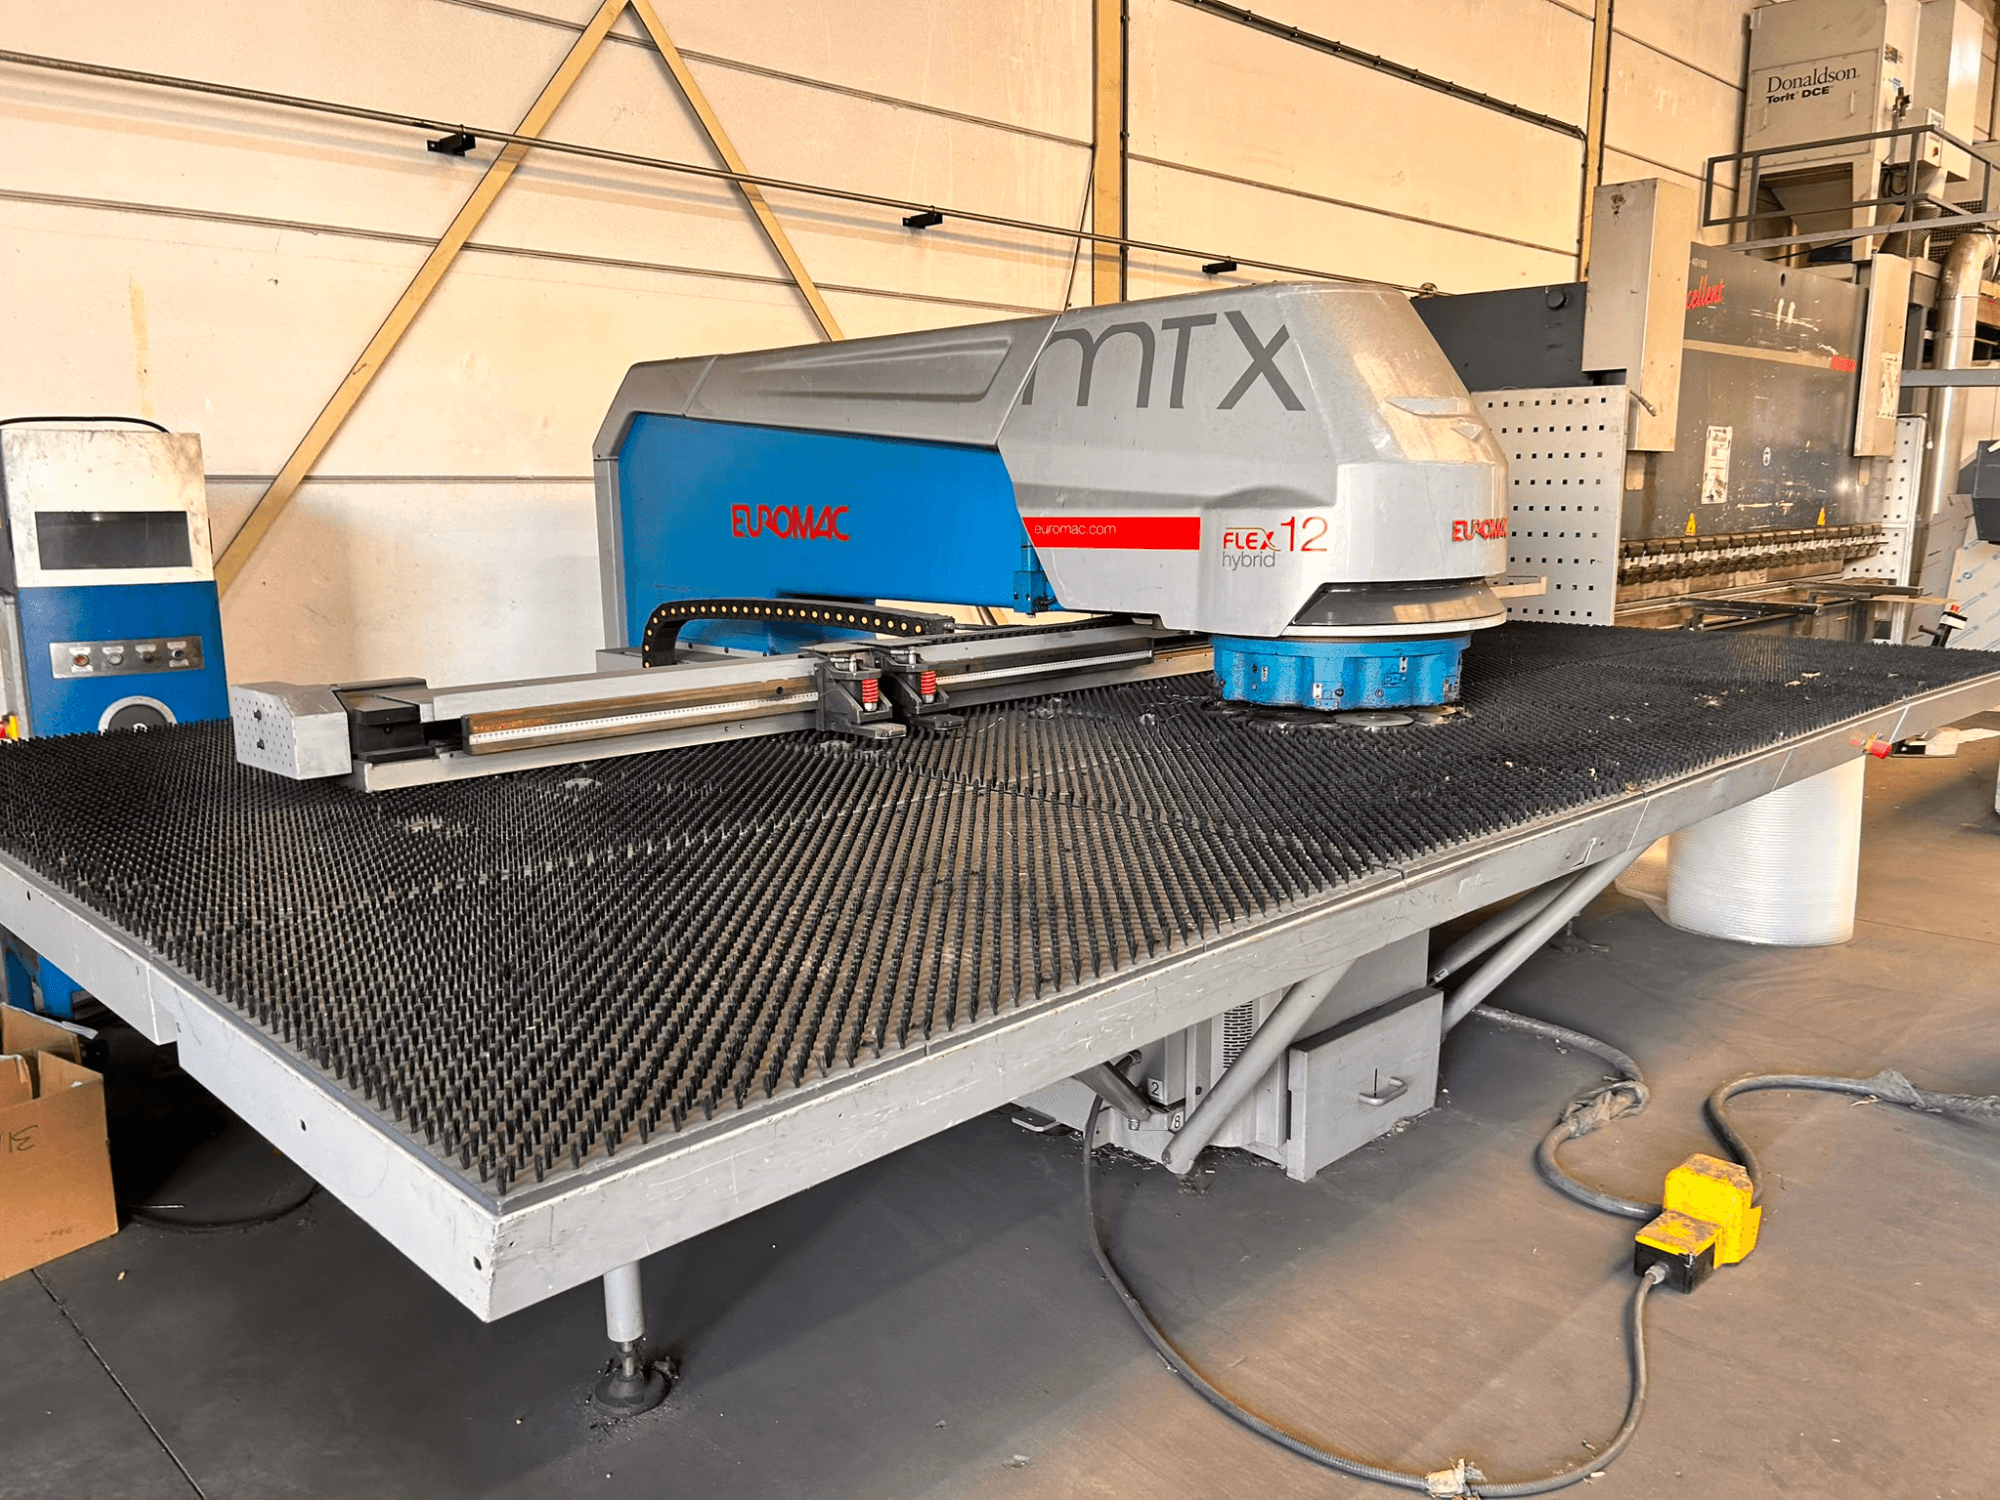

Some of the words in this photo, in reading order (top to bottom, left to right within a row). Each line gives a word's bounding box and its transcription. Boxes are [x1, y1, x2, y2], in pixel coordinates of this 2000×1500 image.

[1801, 85, 1830, 98] DCE
[731, 503, 850, 541] EUROMAC
[1034, 524, 1117, 535] euromac.com
[1452, 518, 1508, 542] EUROMA
[1223, 526, 1281, 552] FLEX
[1280, 516, 1328, 552] 12
[1222, 551, 1276, 571] hybrid
[1151, 1081, 1160, 1097] 2
[1174, 1114, 1181, 1129] 8
